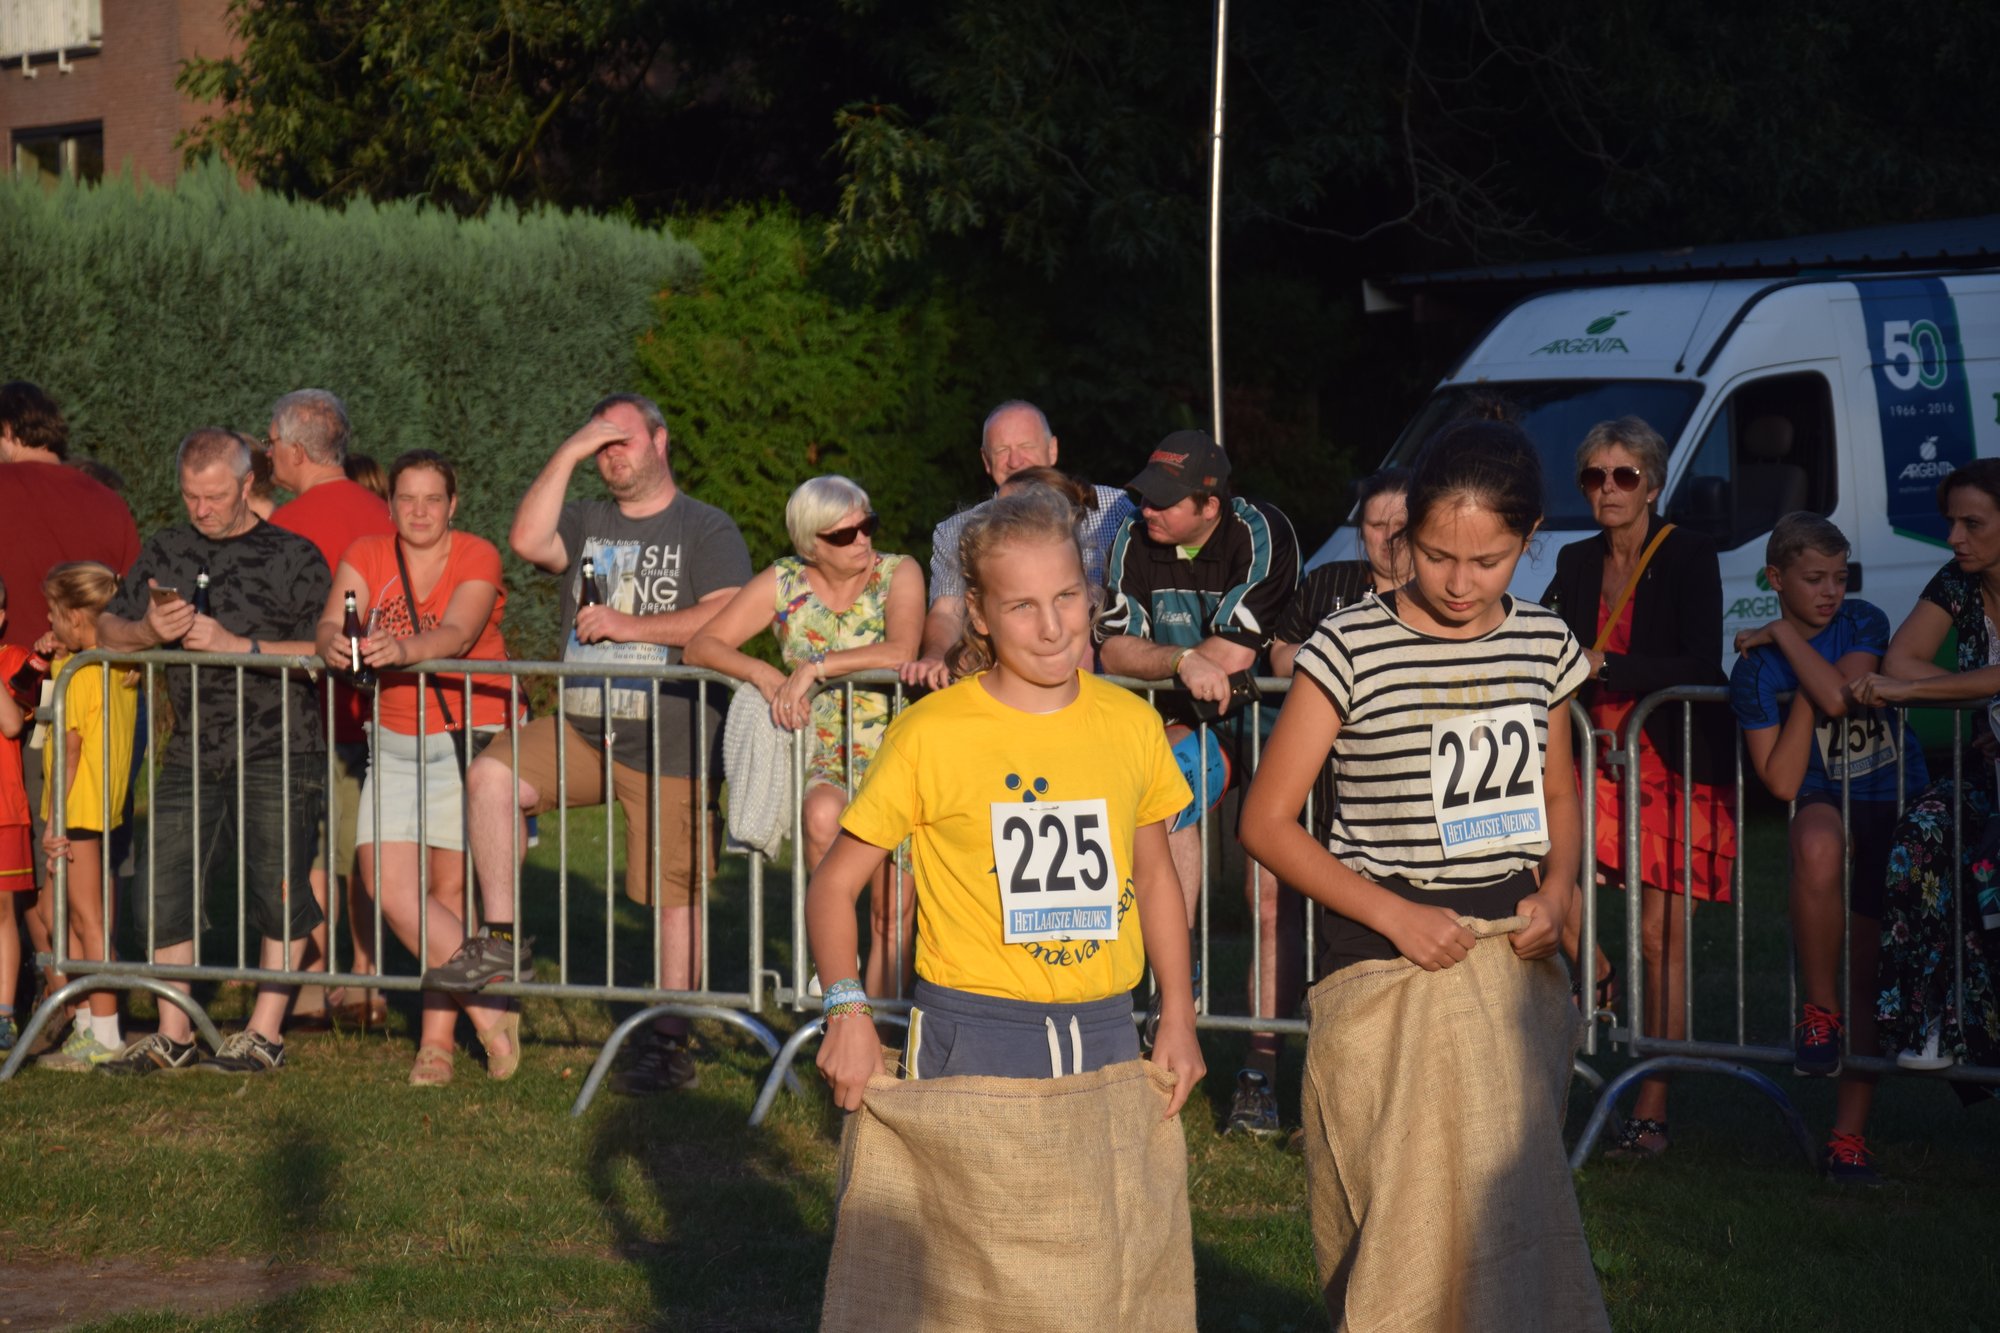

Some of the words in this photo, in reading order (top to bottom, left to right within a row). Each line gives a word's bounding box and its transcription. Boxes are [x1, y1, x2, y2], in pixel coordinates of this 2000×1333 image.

[1528, 337, 1629, 355] ARGENTA
[1883, 319, 1948, 391] 50
[1890, 405, 1917, 417] 1966
[1928, 403, 1955, 415] 2016
[642, 545, 681, 569] SH
[641, 568, 680, 577] CHINESE
[640, 603, 676, 612] DREAM
[1723, 596, 1778, 619] ARGE
[1821, 709, 1885, 758] 254
[1438, 720, 1534, 809] 222
[1446, 823, 1464, 844] HET
[1463, 817, 1501, 840] LAATSTE
[1500, 812, 1536, 834] NIEUWS
[1002, 814, 1108, 893] 225
[1014, 911, 1034, 932] HET
[1034, 910, 1071, 931] LAATSTE
[1071, 908, 1107, 928] NIEUWS
[1022, 941, 1073, 966] onde
